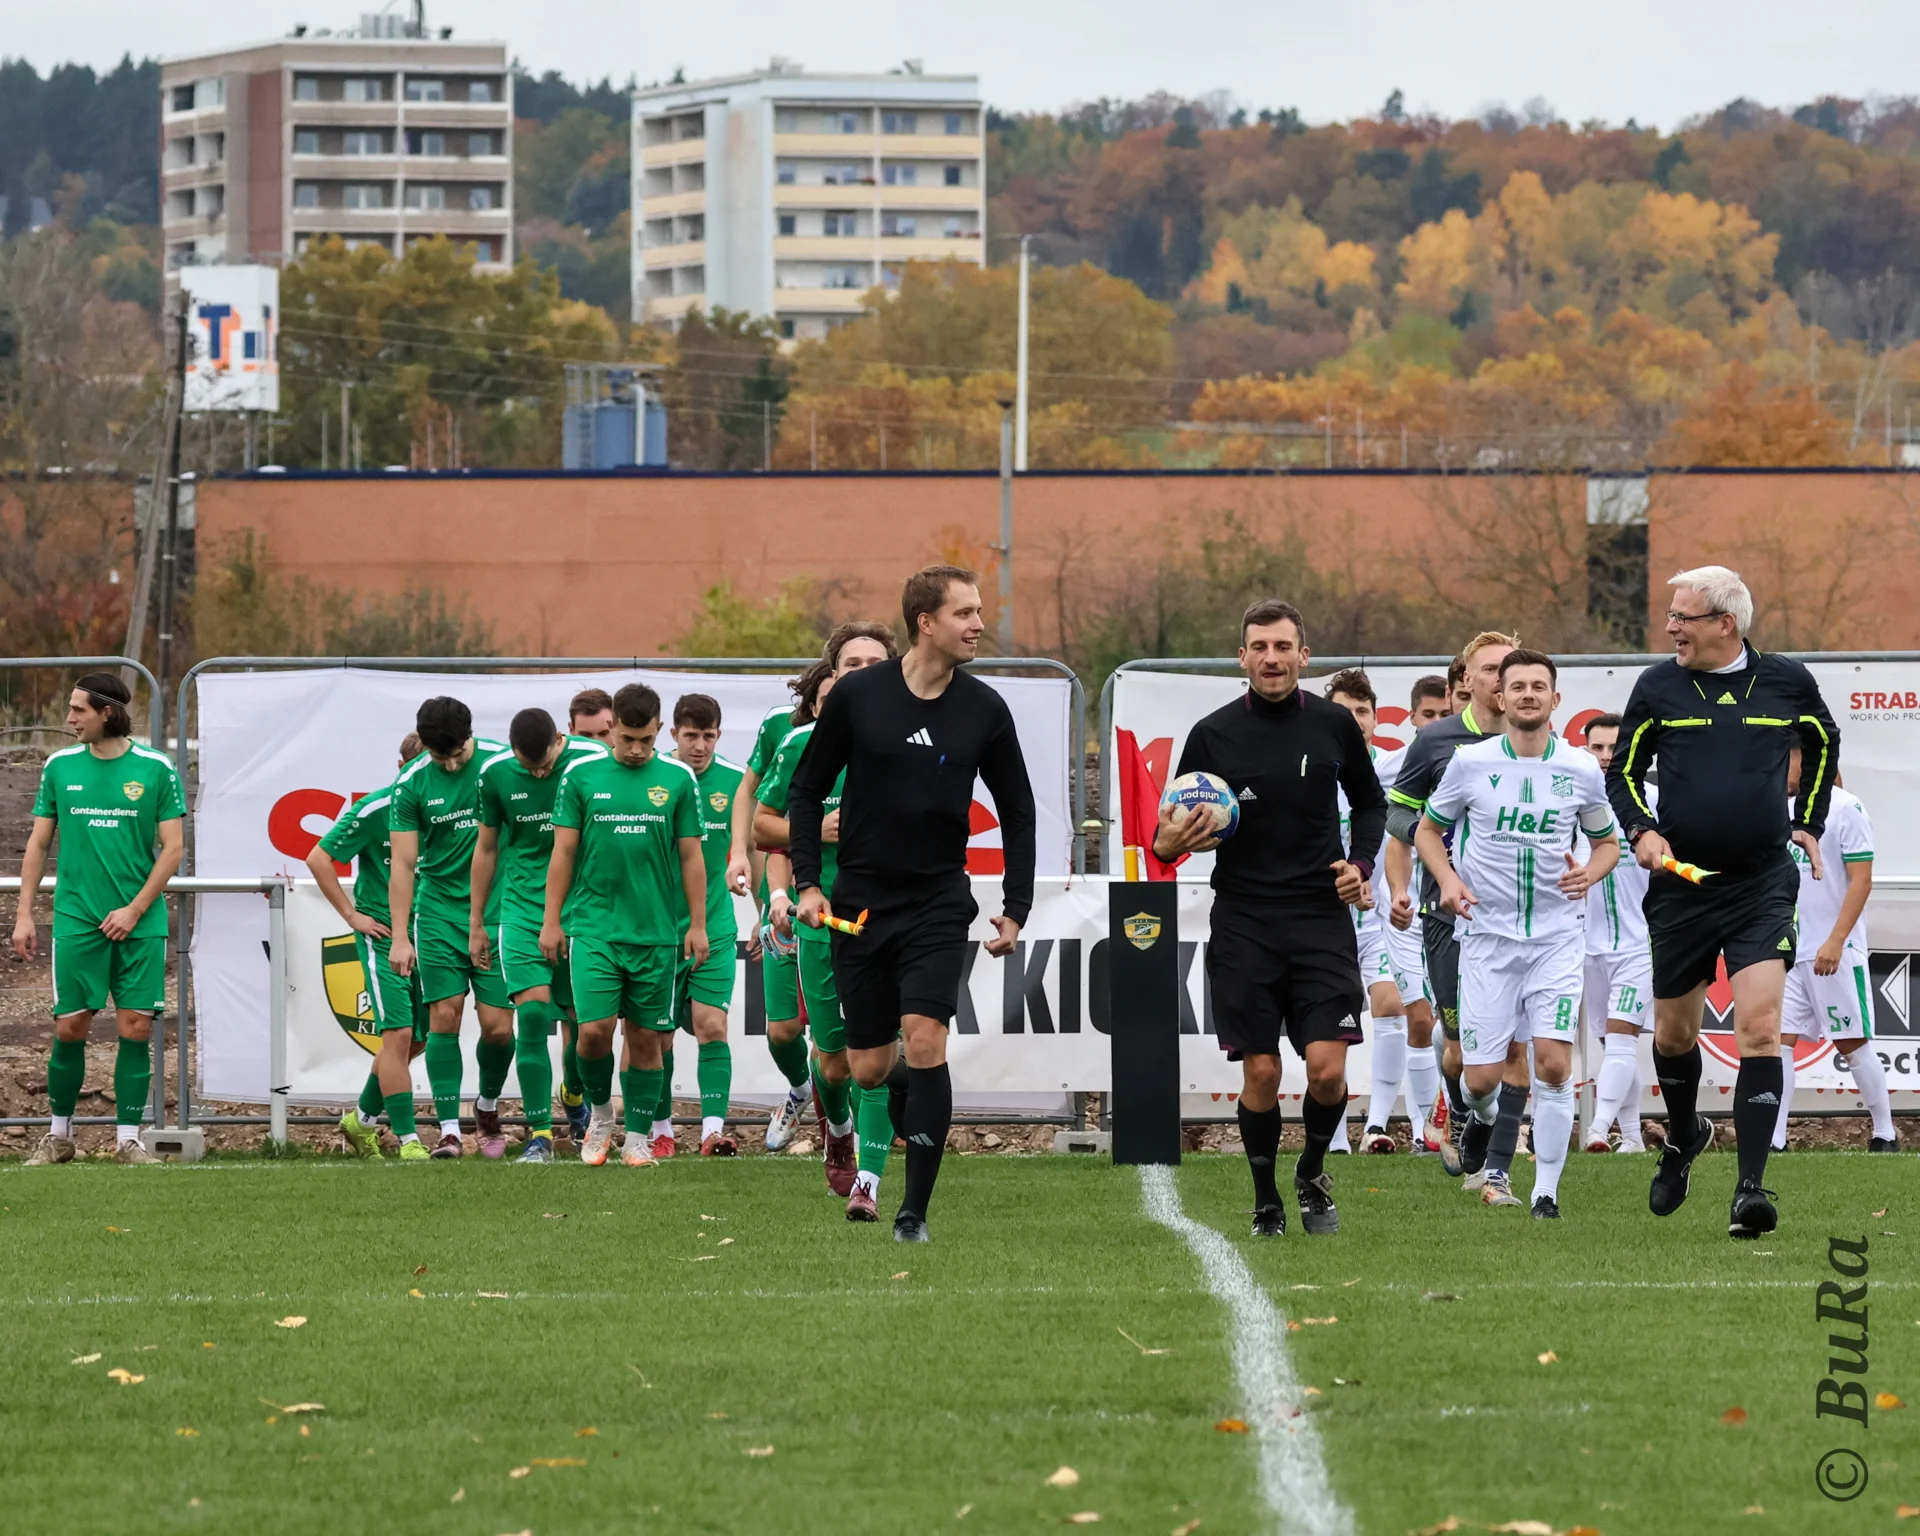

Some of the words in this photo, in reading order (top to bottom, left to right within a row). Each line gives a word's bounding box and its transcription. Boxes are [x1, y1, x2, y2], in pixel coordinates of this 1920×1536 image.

[1850, 692, 1920, 710] STRAB
[1850, 713, 1880, 721] WORK
[1883, 713, 1898, 721] ON
[511, 792, 528, 800] JAKO
[1178, 790, 1220, 802] uhlsport
[427, 798, 445, 806] JAKO
[70, 806, 138, 817] Containerdienst
[594, 813, 665, 823] Containerdienst
[1496, 806, 1560, 834] H&E
[88, 819, 119, 828] ADLER
[614, 825, 647, 834] ADLER
[1491, 834, 1538, 844] Bohrtechnik
[1616, 985, 1637, 1013] 10
[1554, 997, 1572, 1031] 8
[1827, 1006, 1842, 1032] 5
[528, 1108, 548, 1116] JAKO
[632, 1107, 653, 1116] JAKO
[865, 1140, 888, 1150] JAKO
